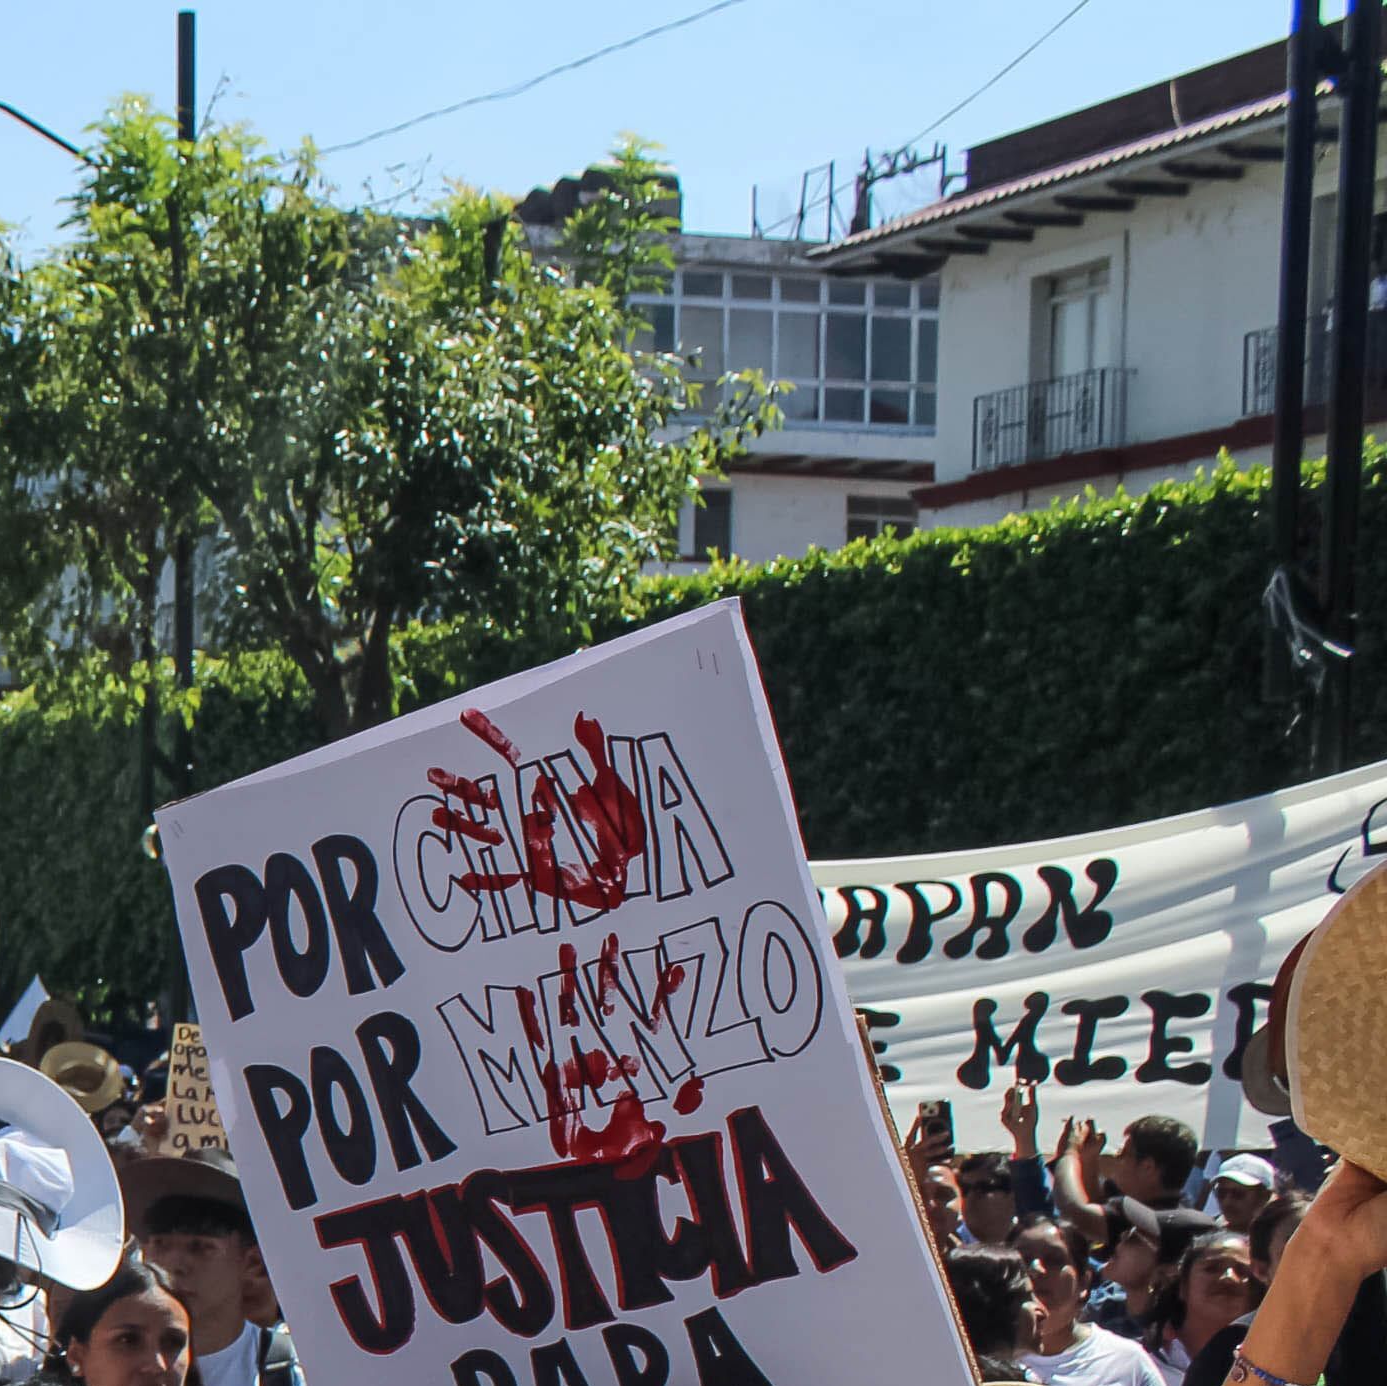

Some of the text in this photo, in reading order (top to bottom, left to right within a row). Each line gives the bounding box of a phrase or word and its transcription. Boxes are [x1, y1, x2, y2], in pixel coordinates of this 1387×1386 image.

[195, 732, 734, 1020] POR CHAVA
[819, 859, 1120, 964] APAN
[246, 900, 822, 1210] POR MANZO
[316, 1107, 858, 1356] JUSTICIA
